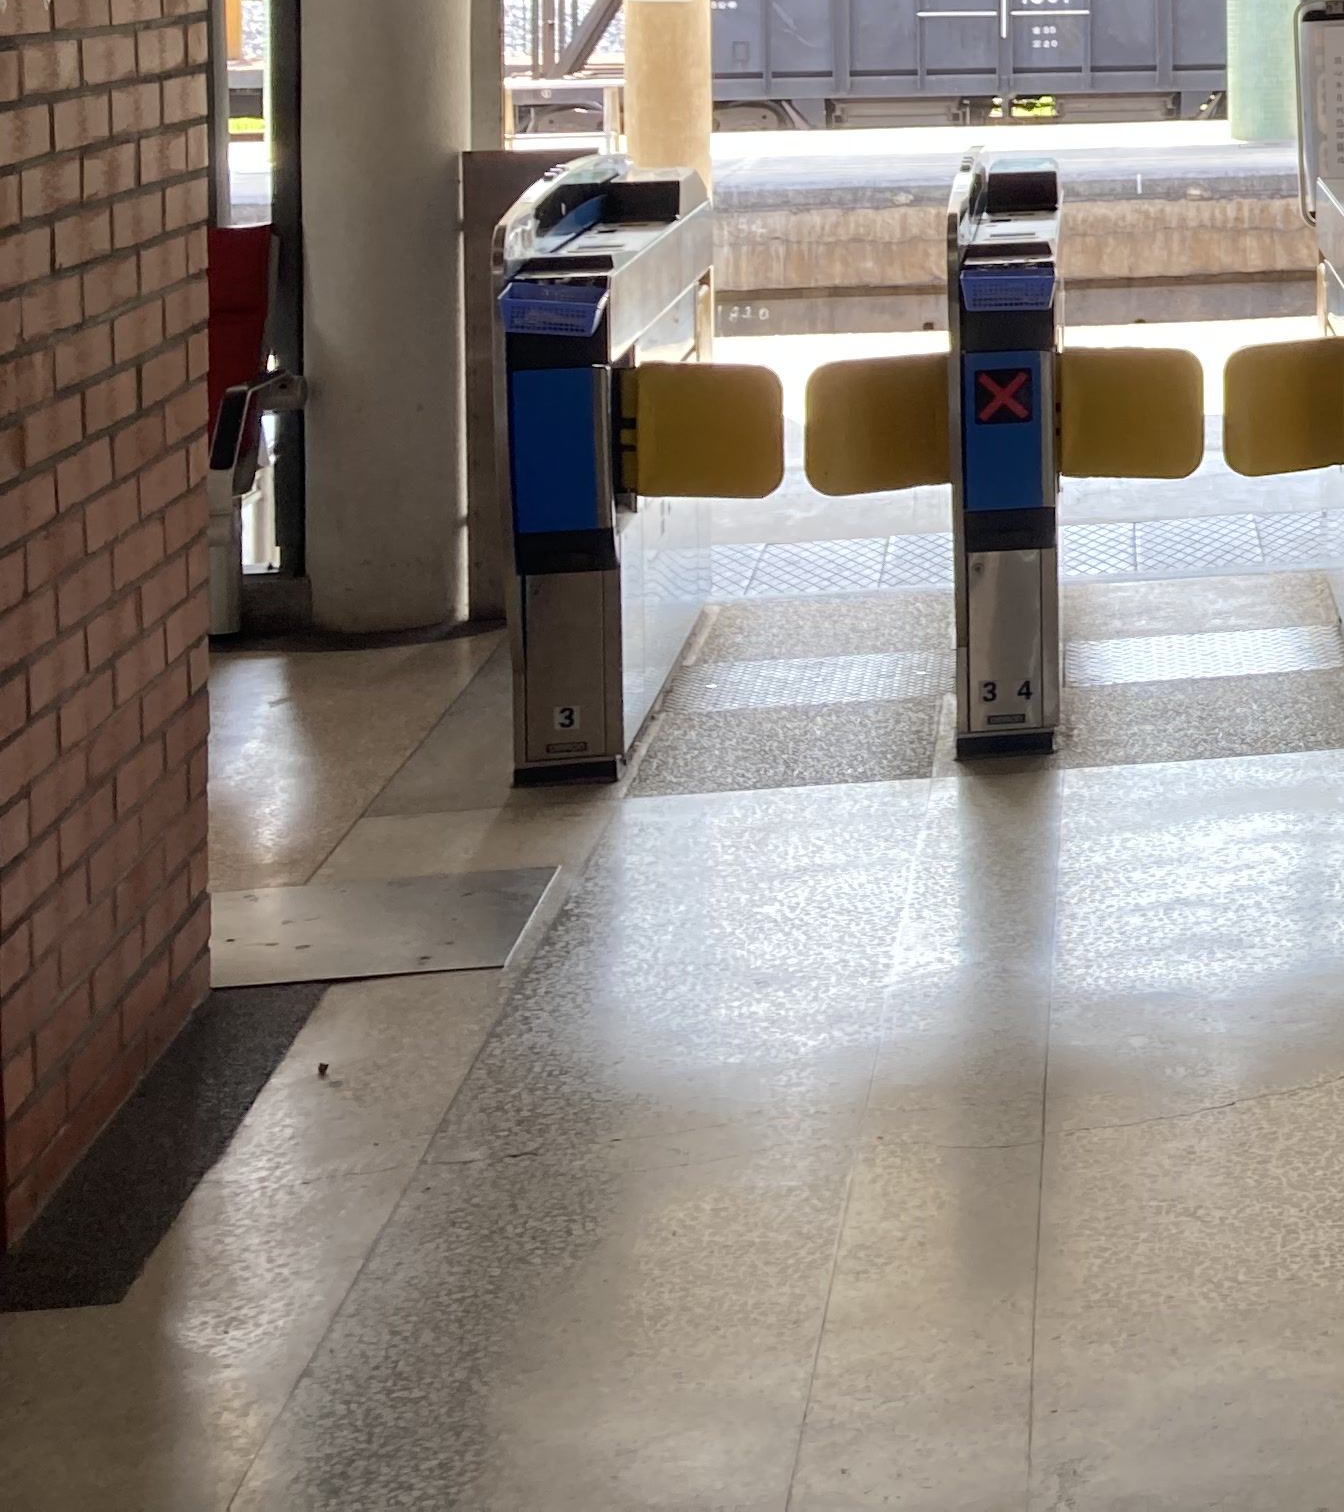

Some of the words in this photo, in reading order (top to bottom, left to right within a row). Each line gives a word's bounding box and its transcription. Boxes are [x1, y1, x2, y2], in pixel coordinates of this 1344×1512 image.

[983, 682, 997, 702] 3
[1017, 680, 1032, 700] 4
[559, 708, 575, 728] 3
